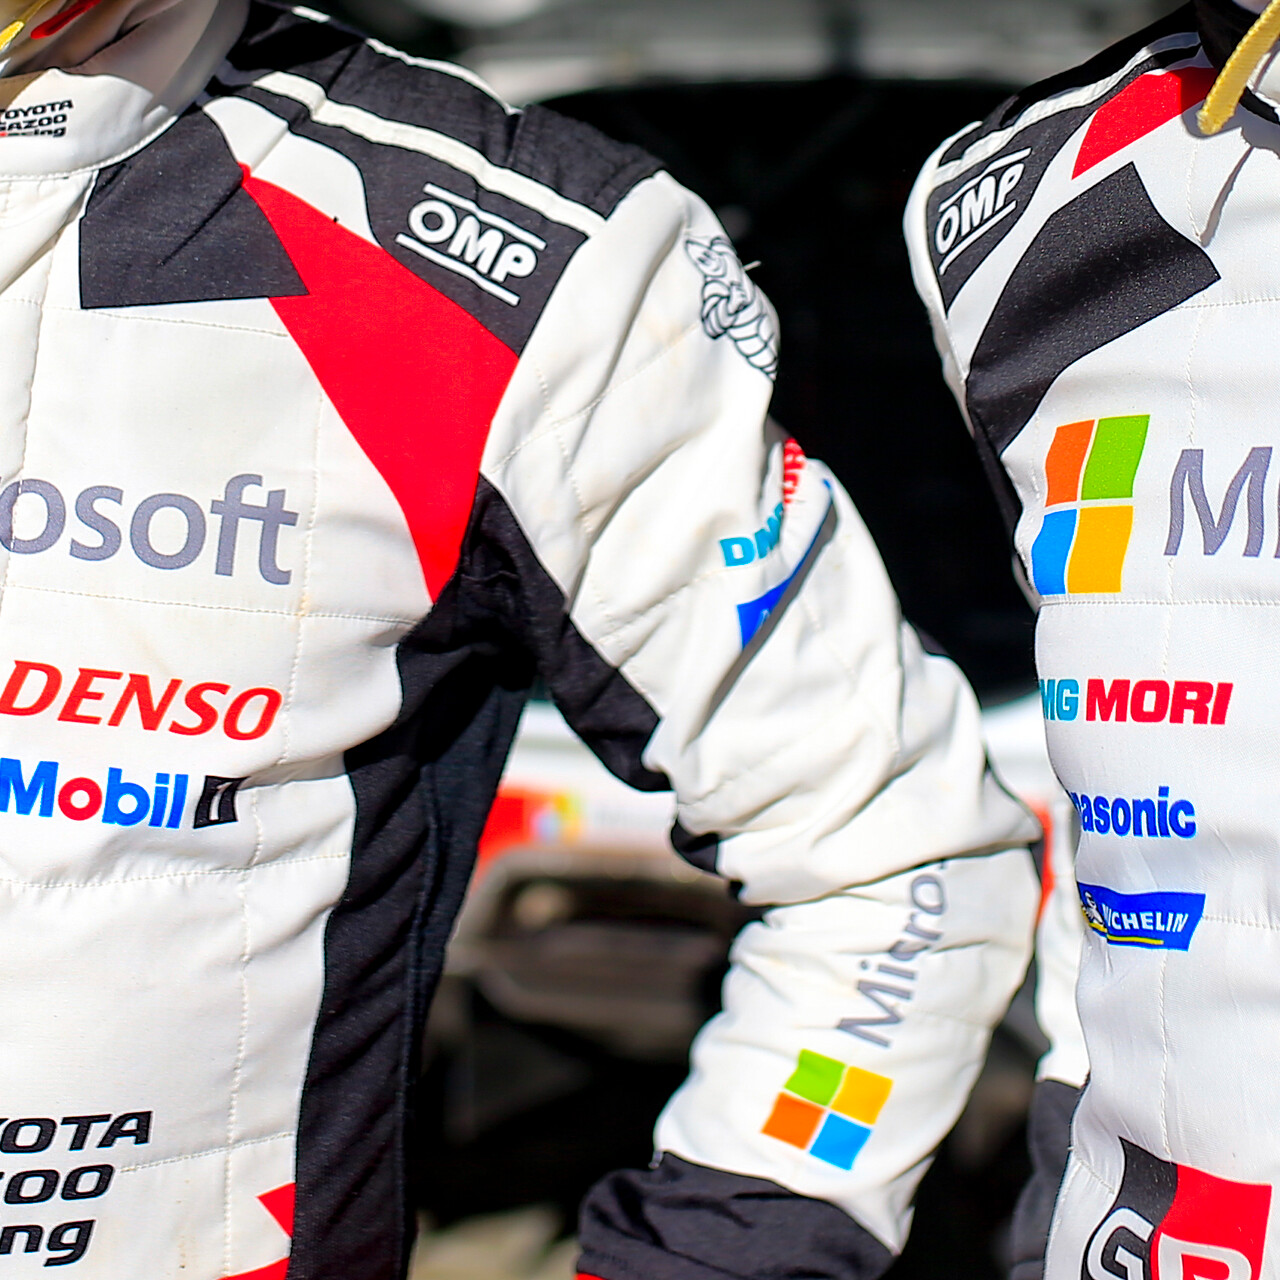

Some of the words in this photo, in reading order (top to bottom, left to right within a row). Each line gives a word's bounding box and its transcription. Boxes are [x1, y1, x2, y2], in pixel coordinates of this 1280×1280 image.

[408, 198, 538, 288] OMP
[935, 163, 1025, 255] OMP
[1040, 679, 1079, 722] MG
[1085, 678, 1234, 725] MORI
[1071, 786, 1197, 839] asonic
[835, 859, 948, 1049] Micro
